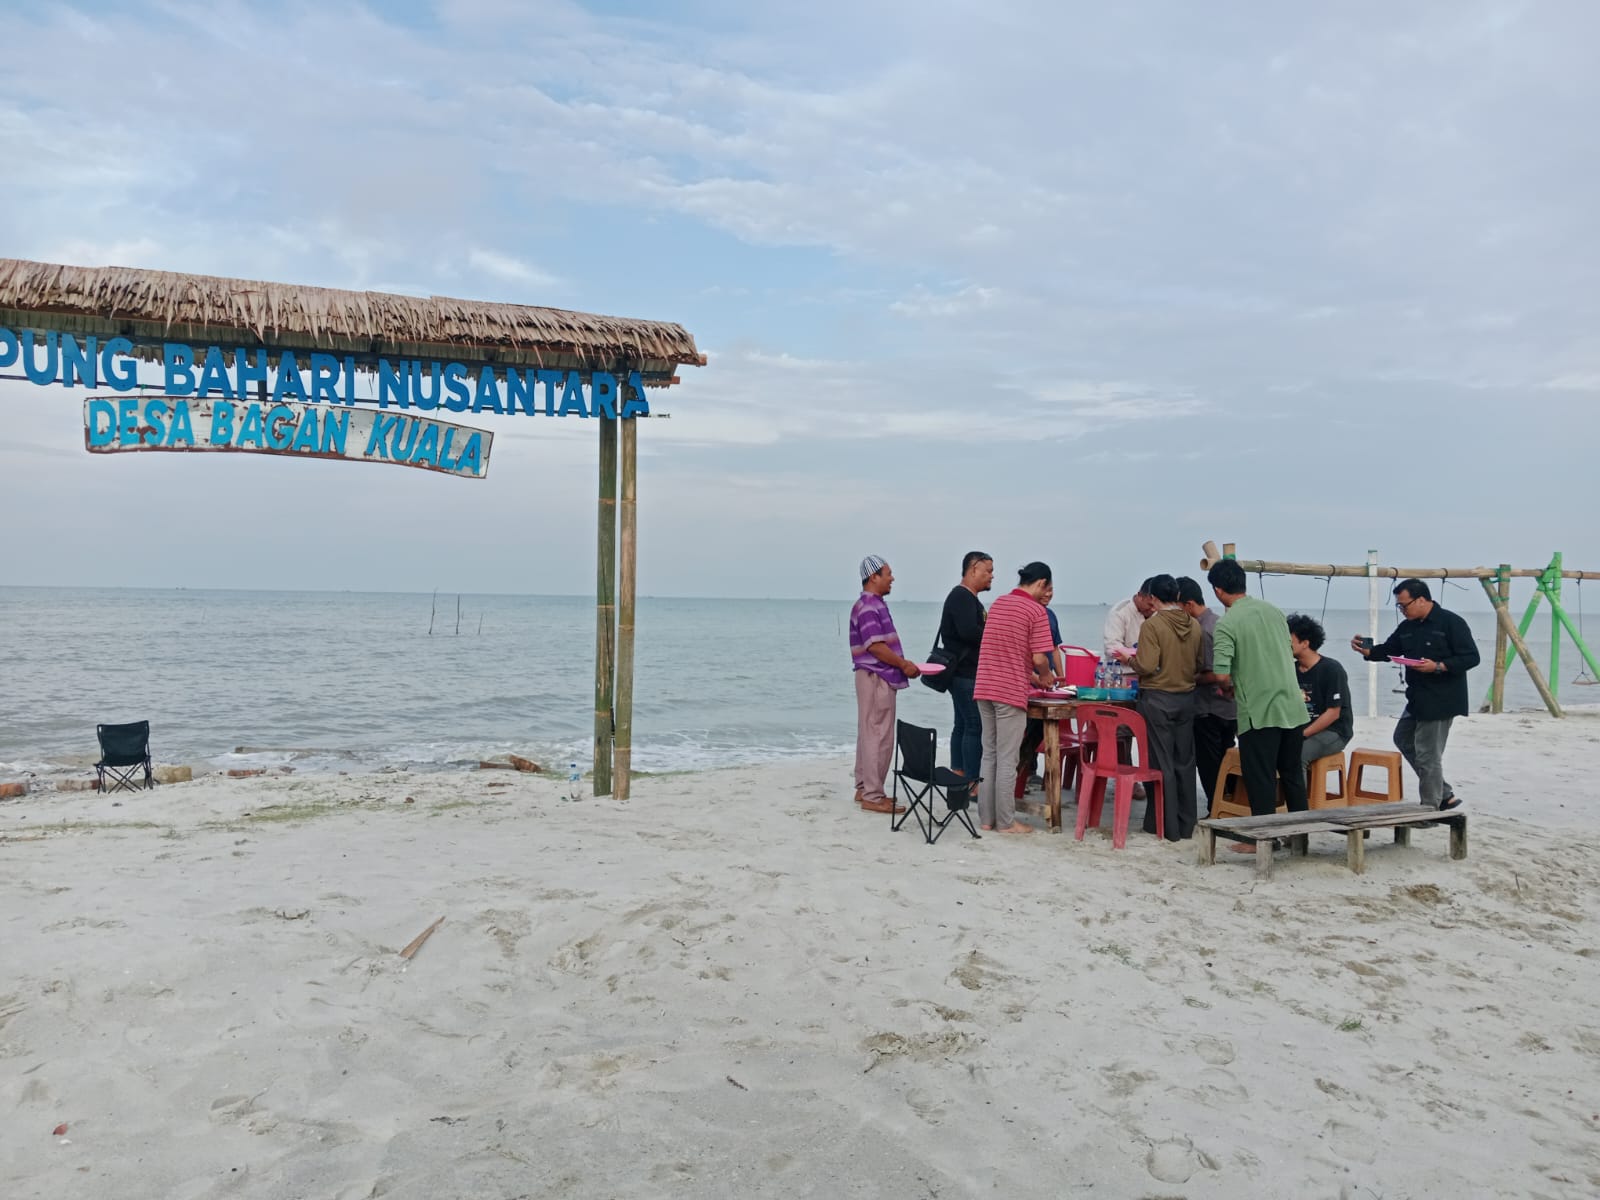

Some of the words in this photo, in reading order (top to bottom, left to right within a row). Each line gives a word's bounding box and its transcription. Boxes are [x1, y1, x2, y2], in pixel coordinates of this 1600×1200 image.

[163, 342, 355, 406] BAHARI
[378, 358, 649, 419] NUSANTARA
[89, 399, 194, 446] DESA
[209, 400, 349, 455] BAGAN
[364, 412, 482, 475] KUALA
